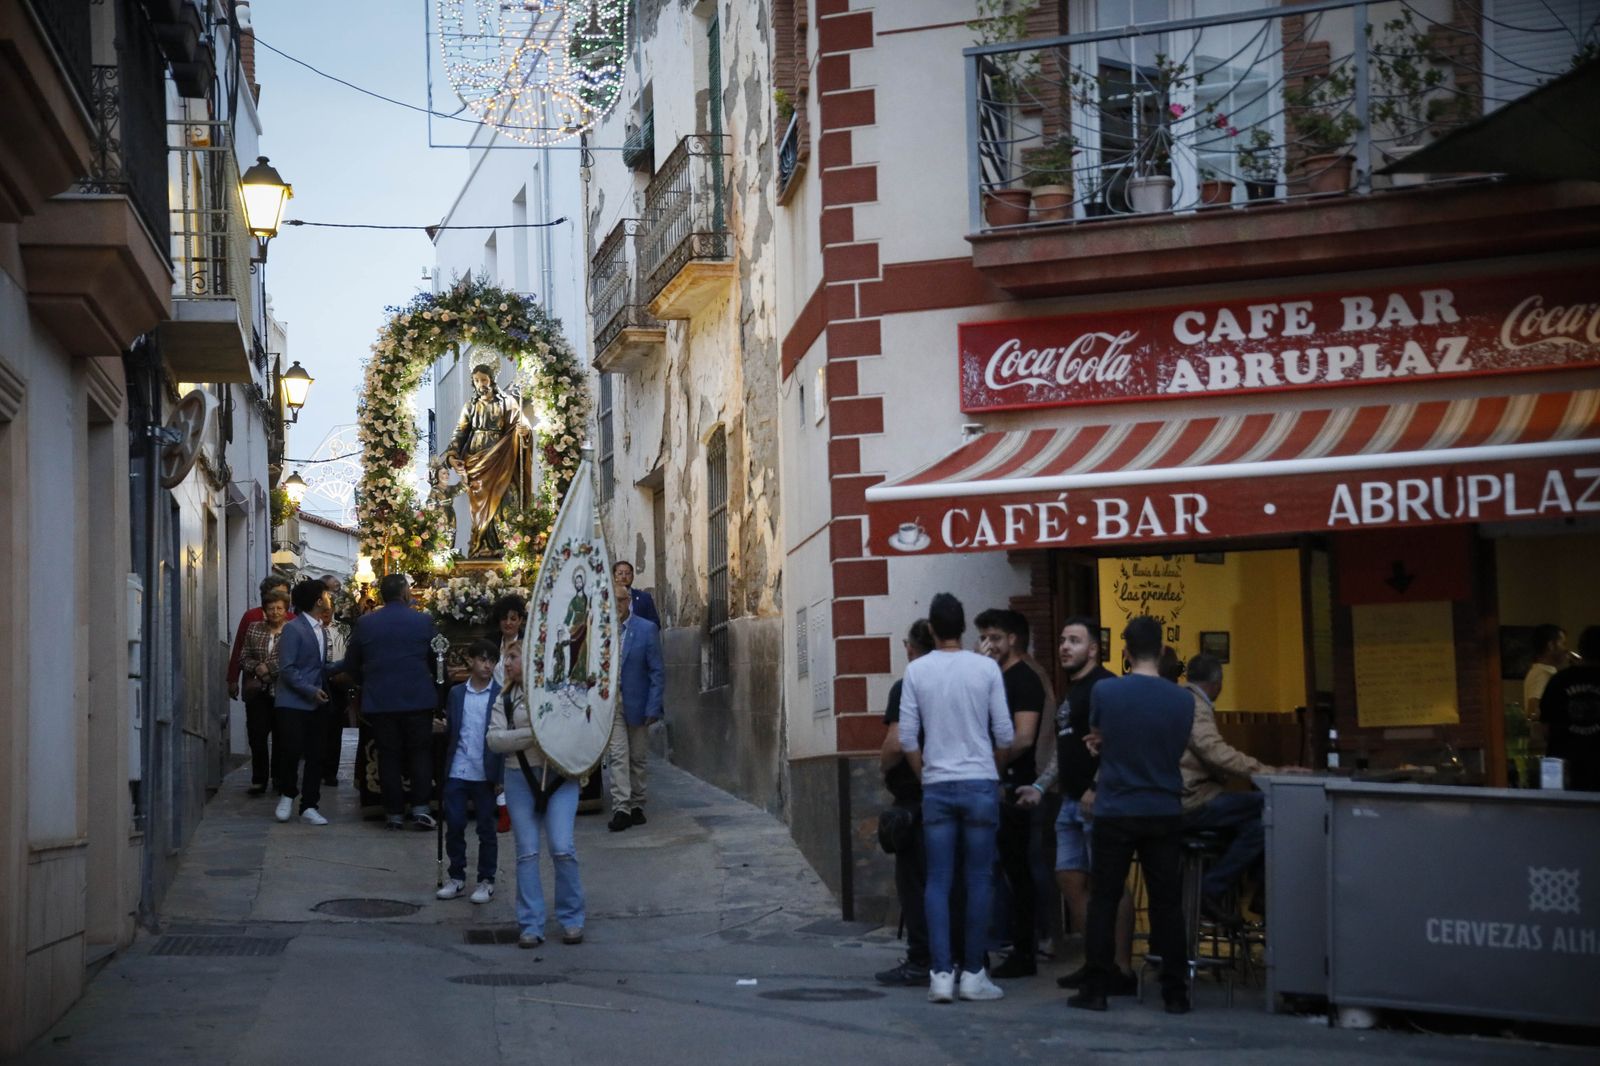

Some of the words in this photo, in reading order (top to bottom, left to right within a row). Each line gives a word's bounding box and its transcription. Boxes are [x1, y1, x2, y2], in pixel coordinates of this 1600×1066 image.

[1172, 300, 1316, 345] CAFE
[1340, 288, 1461, 332] BAR
[985, 329, 1140, 391] Coca-Cola
[1166, 336, 1473, 394] ABRUPLAZ
[1327, 467, 1600, 526] ABRUPLAZ
[1120, 582, 1139, 601] las
[1141, 582, 1182, 608] grandes
[1425, 917, 1543, 951] CERVEZAS
[1552, 924, 1600, 954] ALH
